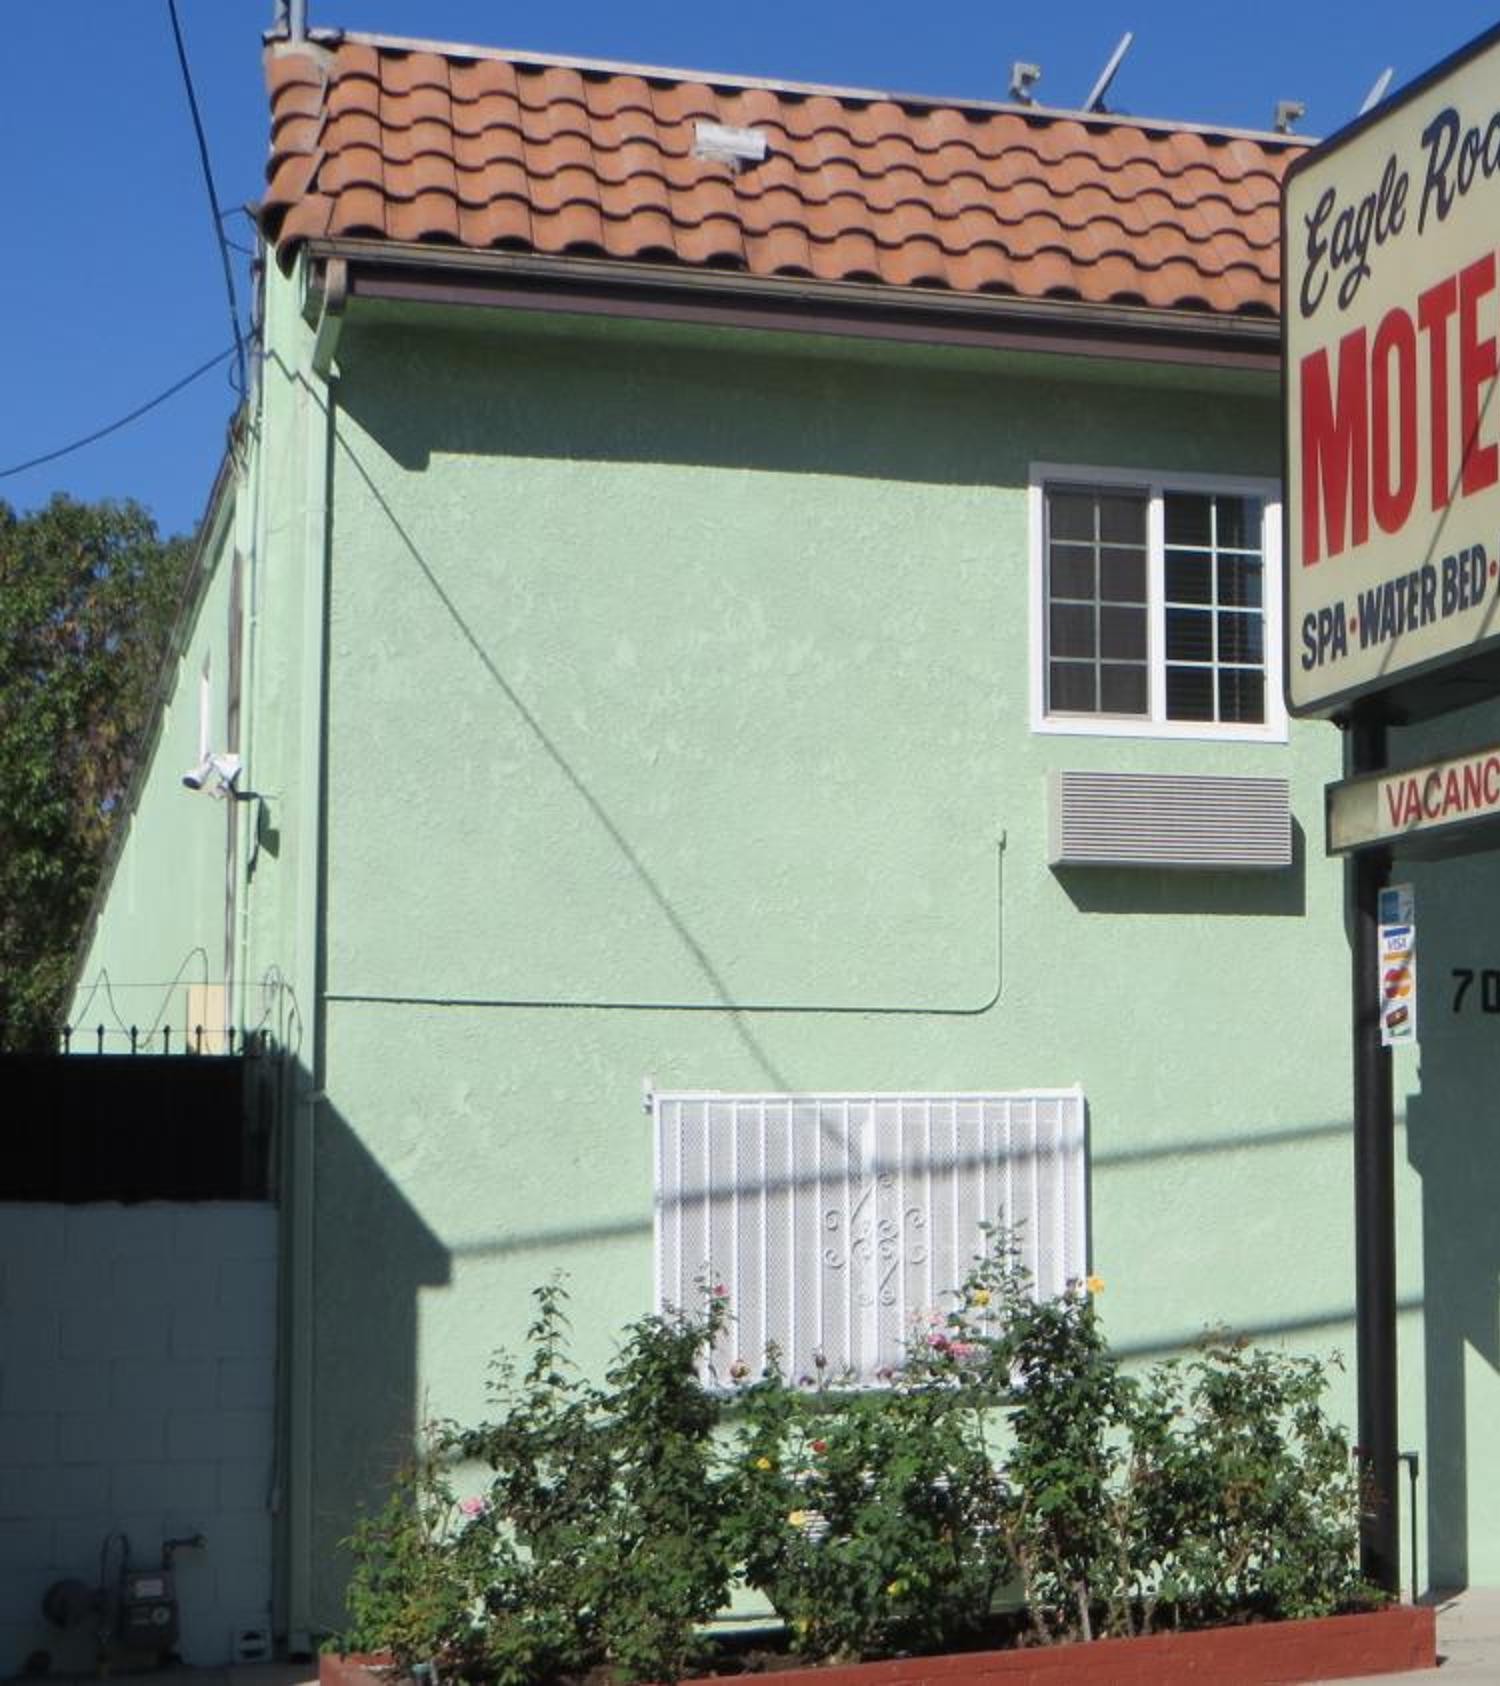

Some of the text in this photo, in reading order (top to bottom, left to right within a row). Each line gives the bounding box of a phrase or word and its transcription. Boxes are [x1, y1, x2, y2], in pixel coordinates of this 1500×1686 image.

[1301, 153, 1408, 318] Eagle
[1301, 601, 1348, 671] SPA
[1357, 565, 1437, 650] WATER
[1441, 543, 1487, 618] BED
